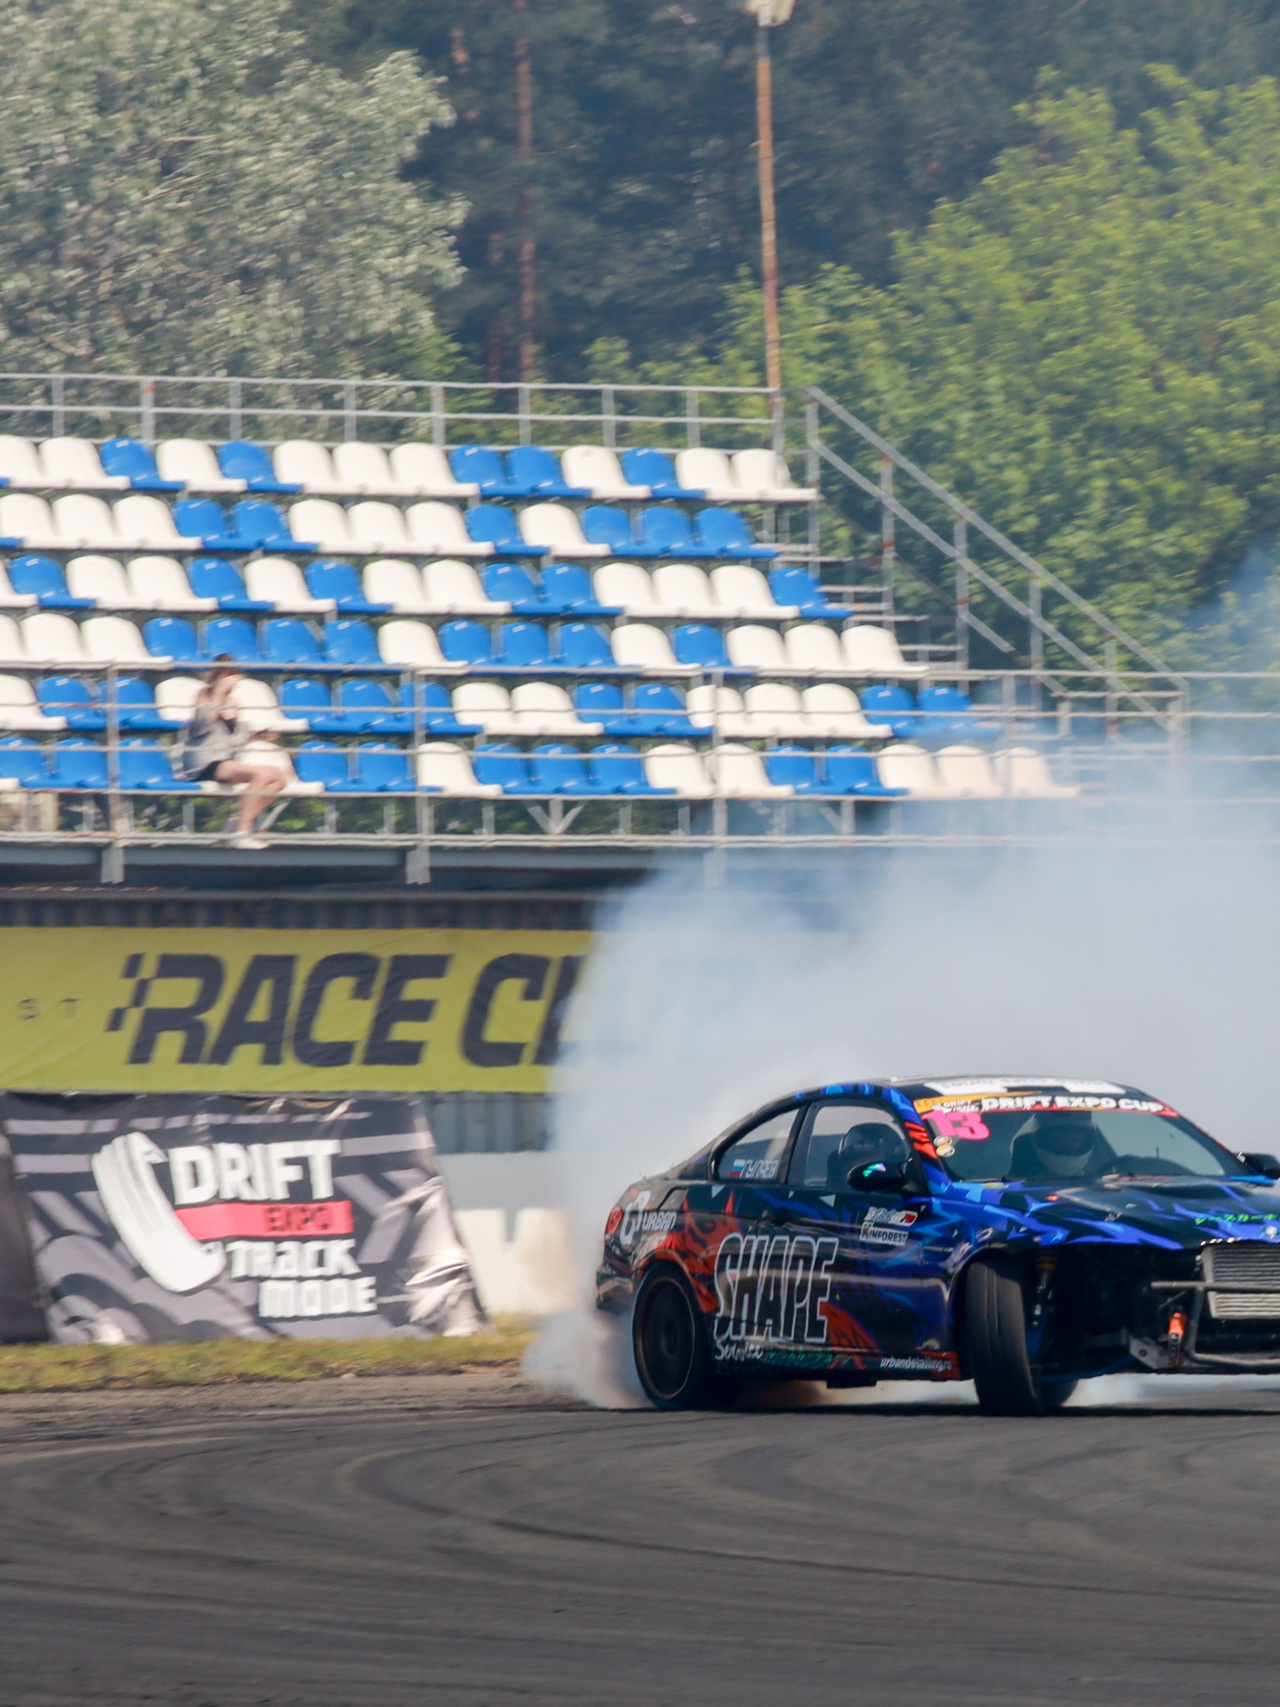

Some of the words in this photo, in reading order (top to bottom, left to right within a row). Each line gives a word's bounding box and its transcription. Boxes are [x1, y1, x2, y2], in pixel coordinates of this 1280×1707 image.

[106, 952, 454, 1066] RACE
[922, 1110, 990, 1141] 13
[981, 1096, 1052, 1110] DRIFT
[1054, 1096, 1118, 1109] EXPO
[1117, 1099, 1164, 1112] CUP
[168, 1139, 341, 1205] DRIFT
[713, 1232, 839, 1342] SHAPE
